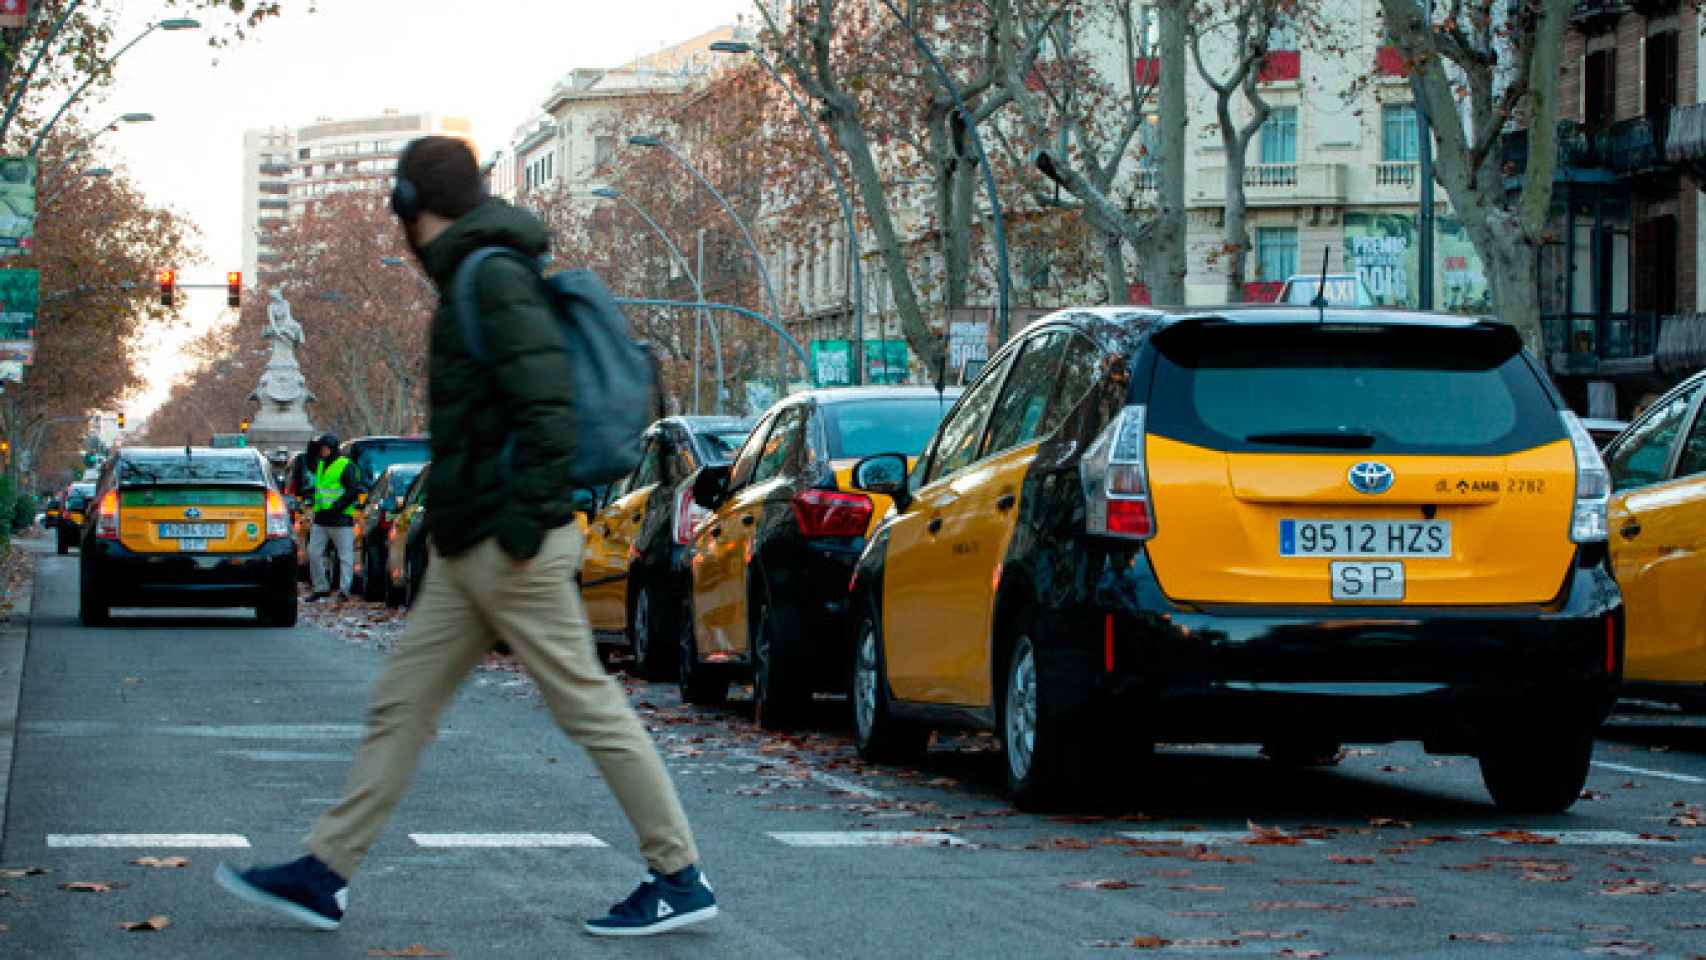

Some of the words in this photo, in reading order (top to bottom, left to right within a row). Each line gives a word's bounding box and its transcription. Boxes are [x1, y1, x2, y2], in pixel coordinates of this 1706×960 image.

[1471, 480, 1499, 491] AMB
[1507, 478, 1545, 494] 2782
[1300, 524, 1377, 552] 9512
[1387, 524, 1442, 552] HZS
